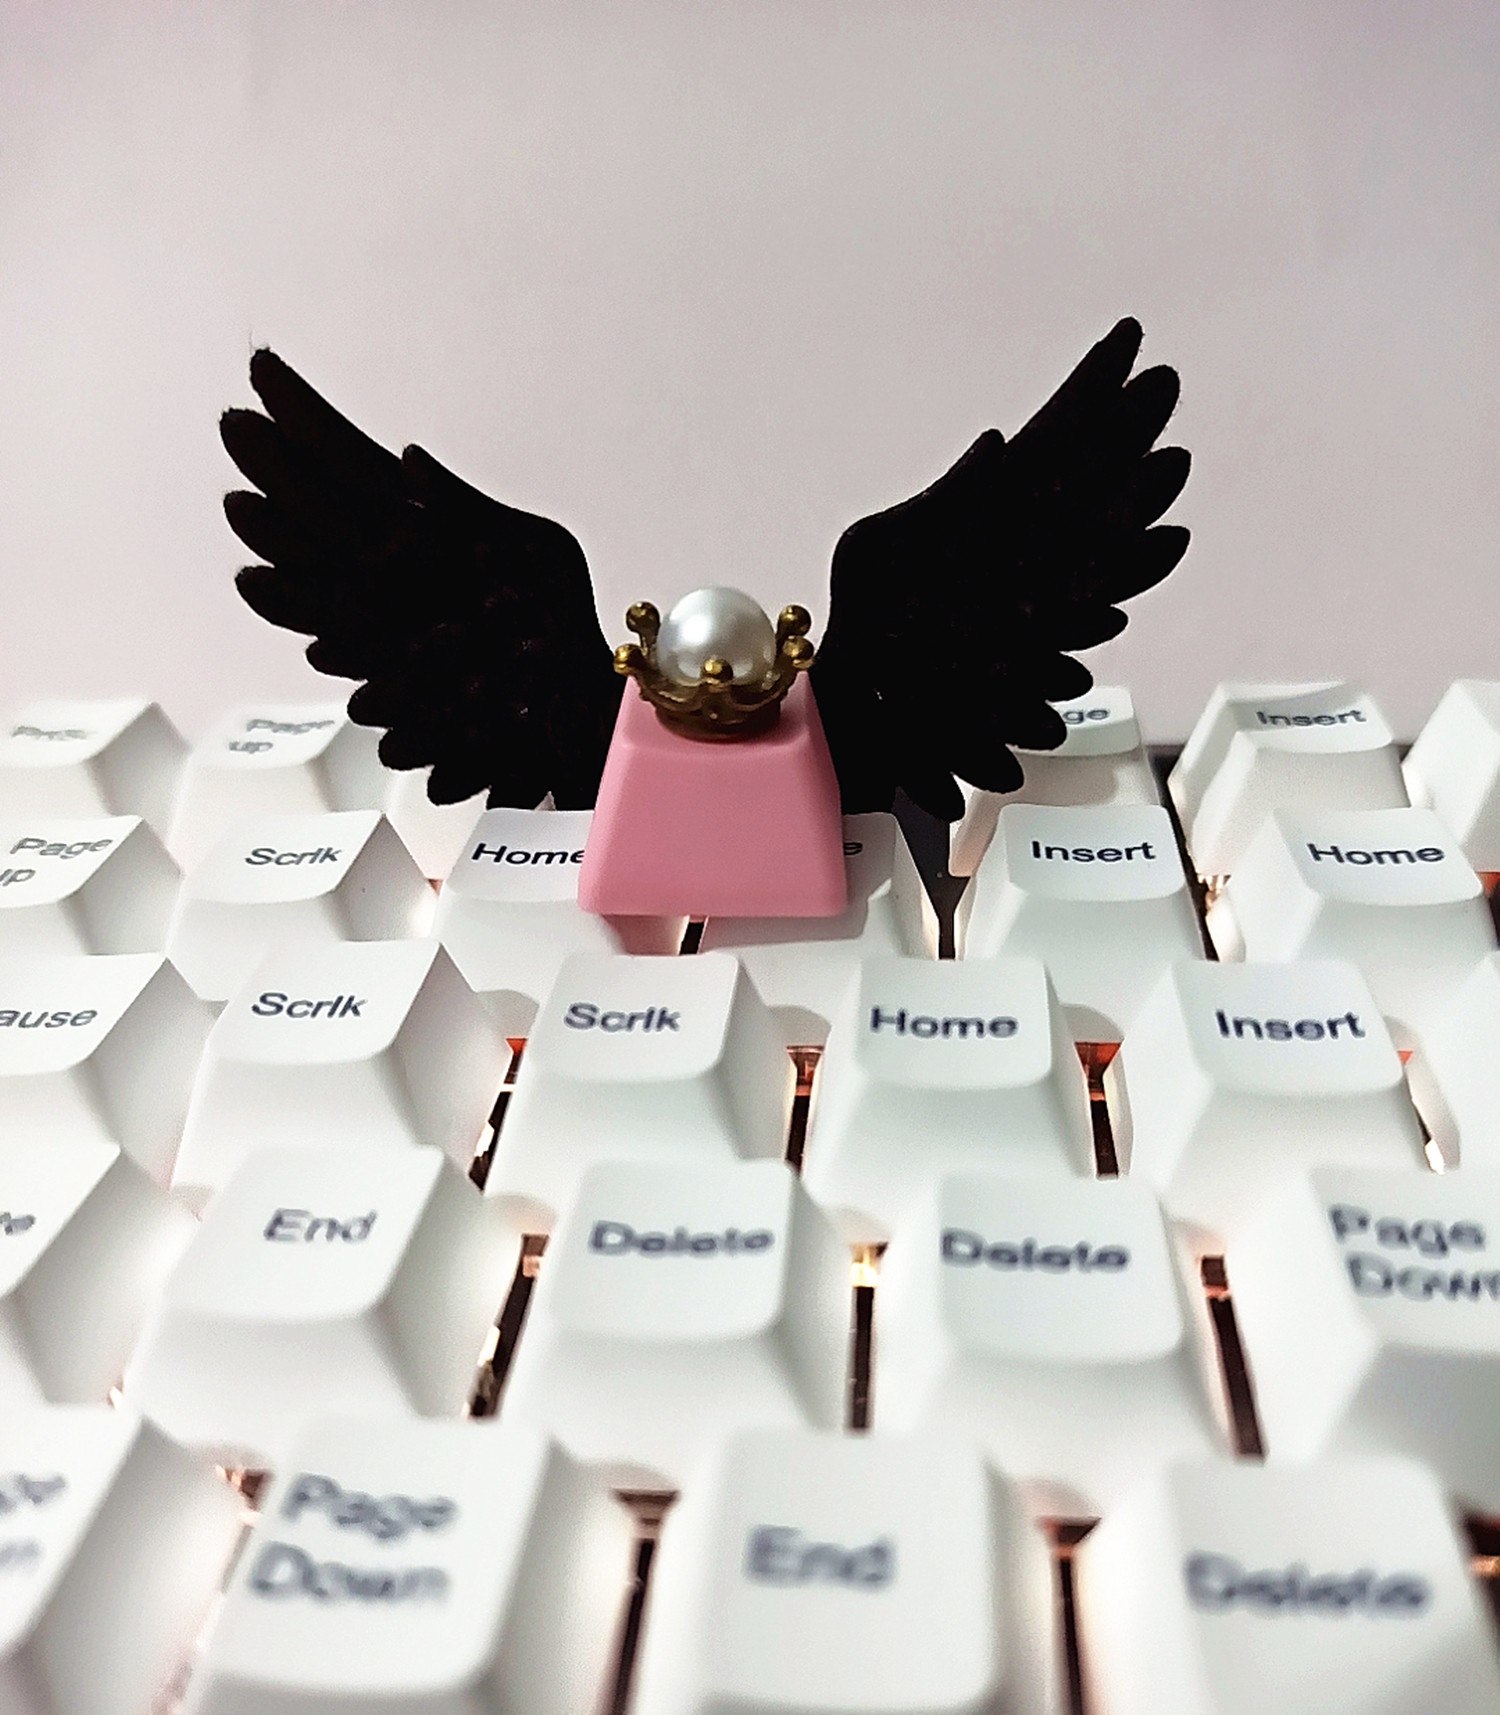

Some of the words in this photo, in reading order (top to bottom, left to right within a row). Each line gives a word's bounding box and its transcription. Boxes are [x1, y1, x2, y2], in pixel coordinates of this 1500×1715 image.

[1257, 709, 1367, 729] Insert
[10, 838, 113, 859] Page
[244, 847, 341, 866] Scrlk
[472, 843, 585, 865] Home
[1032, 840, 1156, 863] Insert
[1307, 842, 1445, 866] Home
[252, 992, 366, 1018] Scrlk
[563, 1002, 681, 1032] Scrlk
[870, 1006, 1018, 1039] Home
[1216, 1009, 1366, 1041] Insert
[264, 1208, 377, 1243] End
[588, 1220, 775, 1258] Delete
[1327, 1203, 1486, 1258] Page
[941, 1227, 1130, 1272] Delete
[744, 1524, 895, 1590] End
